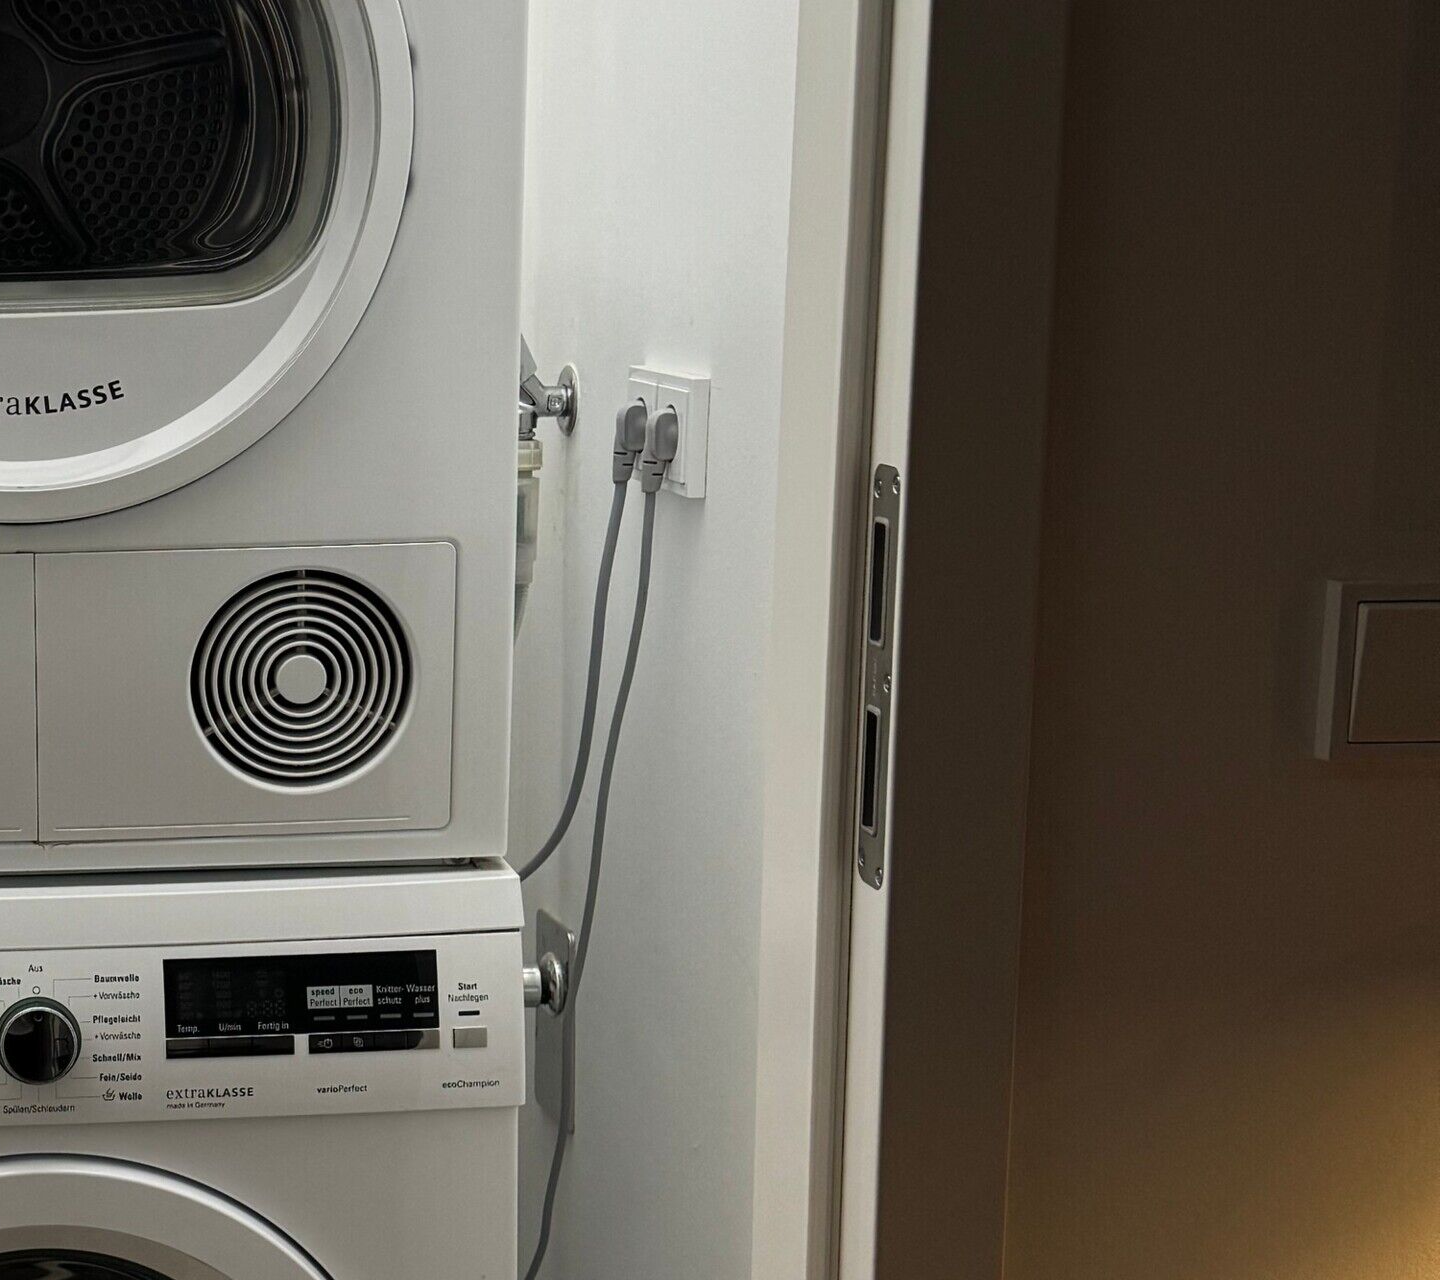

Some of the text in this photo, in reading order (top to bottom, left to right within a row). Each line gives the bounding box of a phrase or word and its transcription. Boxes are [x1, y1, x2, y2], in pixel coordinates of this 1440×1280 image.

[28, 964, 43, 972] Aus
[348, 986, 364, 995] eco
[406, 983, 436, 993] Wasser
[458, 982, 478, 991] Start
[311, 987, 335, 997] speed
[310, 998, 338, 1008] Perfect
[343, 997, 371, 1007] Perfect
[377, 996, 402, 1006] schutz
[414, 994, 431, 1005] plus
[448, 993, 489, 1004] Nachlegen
[92, 1014, 141, 1025] Pflegeleicht
[218, 1022, 242, 1032] U/min
[92, 1053, 142, 1063] Schnell/Mix
[317, 1084, 368, 1094] varioPerfect
[442, 1079, 500, 1090] ecoChampion
[119, 1091, 143, 1101] Wolle
[166, 1087, 254, 1100] extraKLASSE
